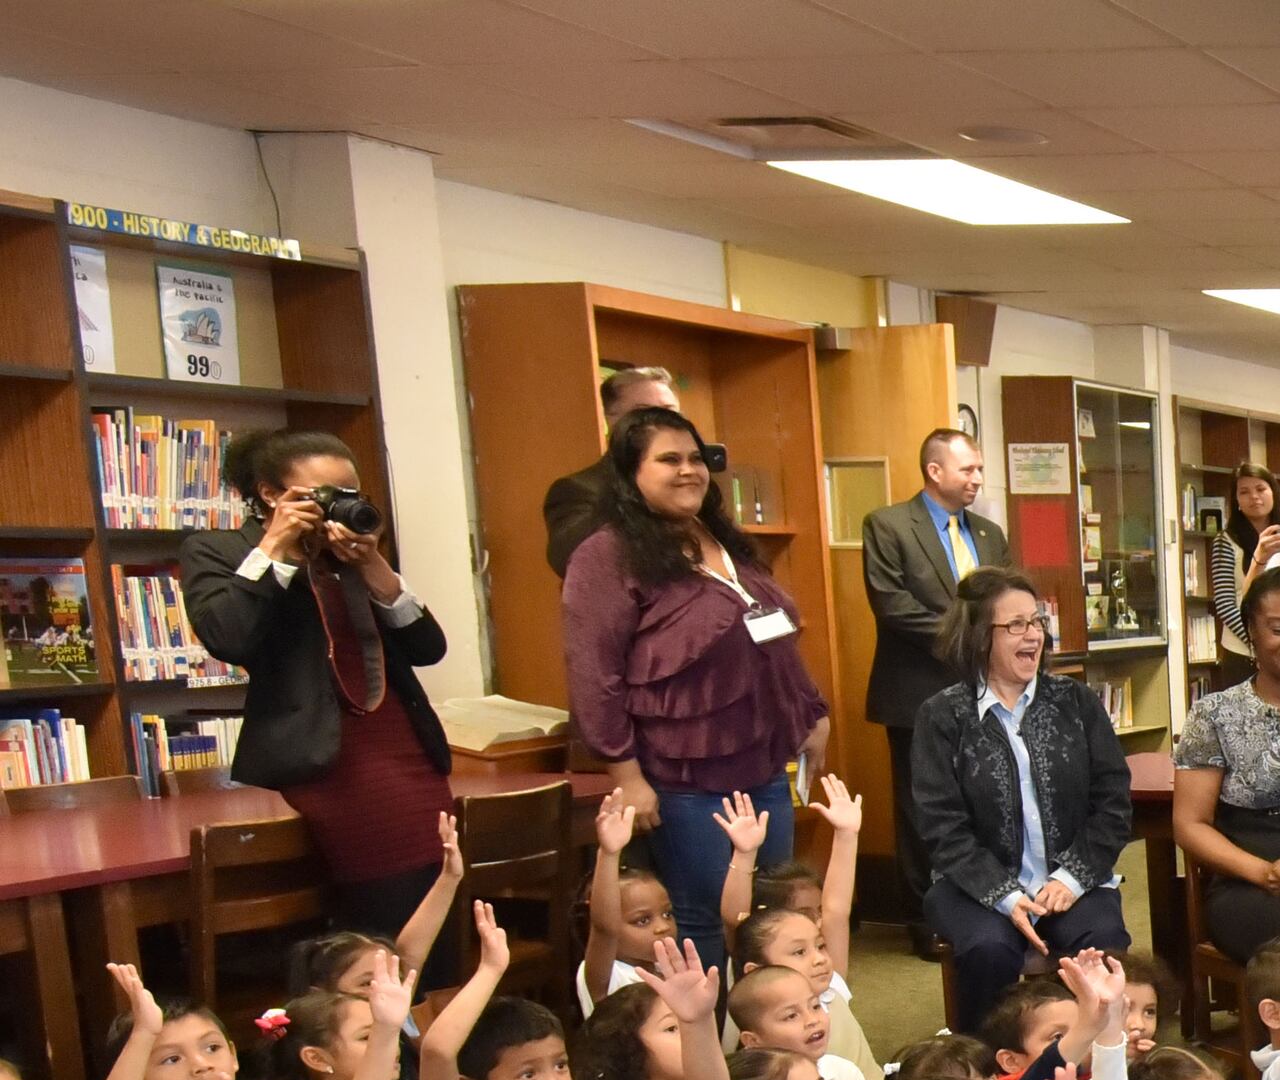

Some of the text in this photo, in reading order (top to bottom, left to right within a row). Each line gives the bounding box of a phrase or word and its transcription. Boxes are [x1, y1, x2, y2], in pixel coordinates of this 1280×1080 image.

[71, 203, 108, 230] 900
[123, 212, 190, 242] HISTORY
[197, 225, 208, 246] &
[211, 228, 296, 257] GEOGRAPH
[173, 276, 213, 290] Australia
[187, 353, 222, 380] 990
[42, 646, 86, 655] SPORTS
[56, 654, 87, 663] MATH
